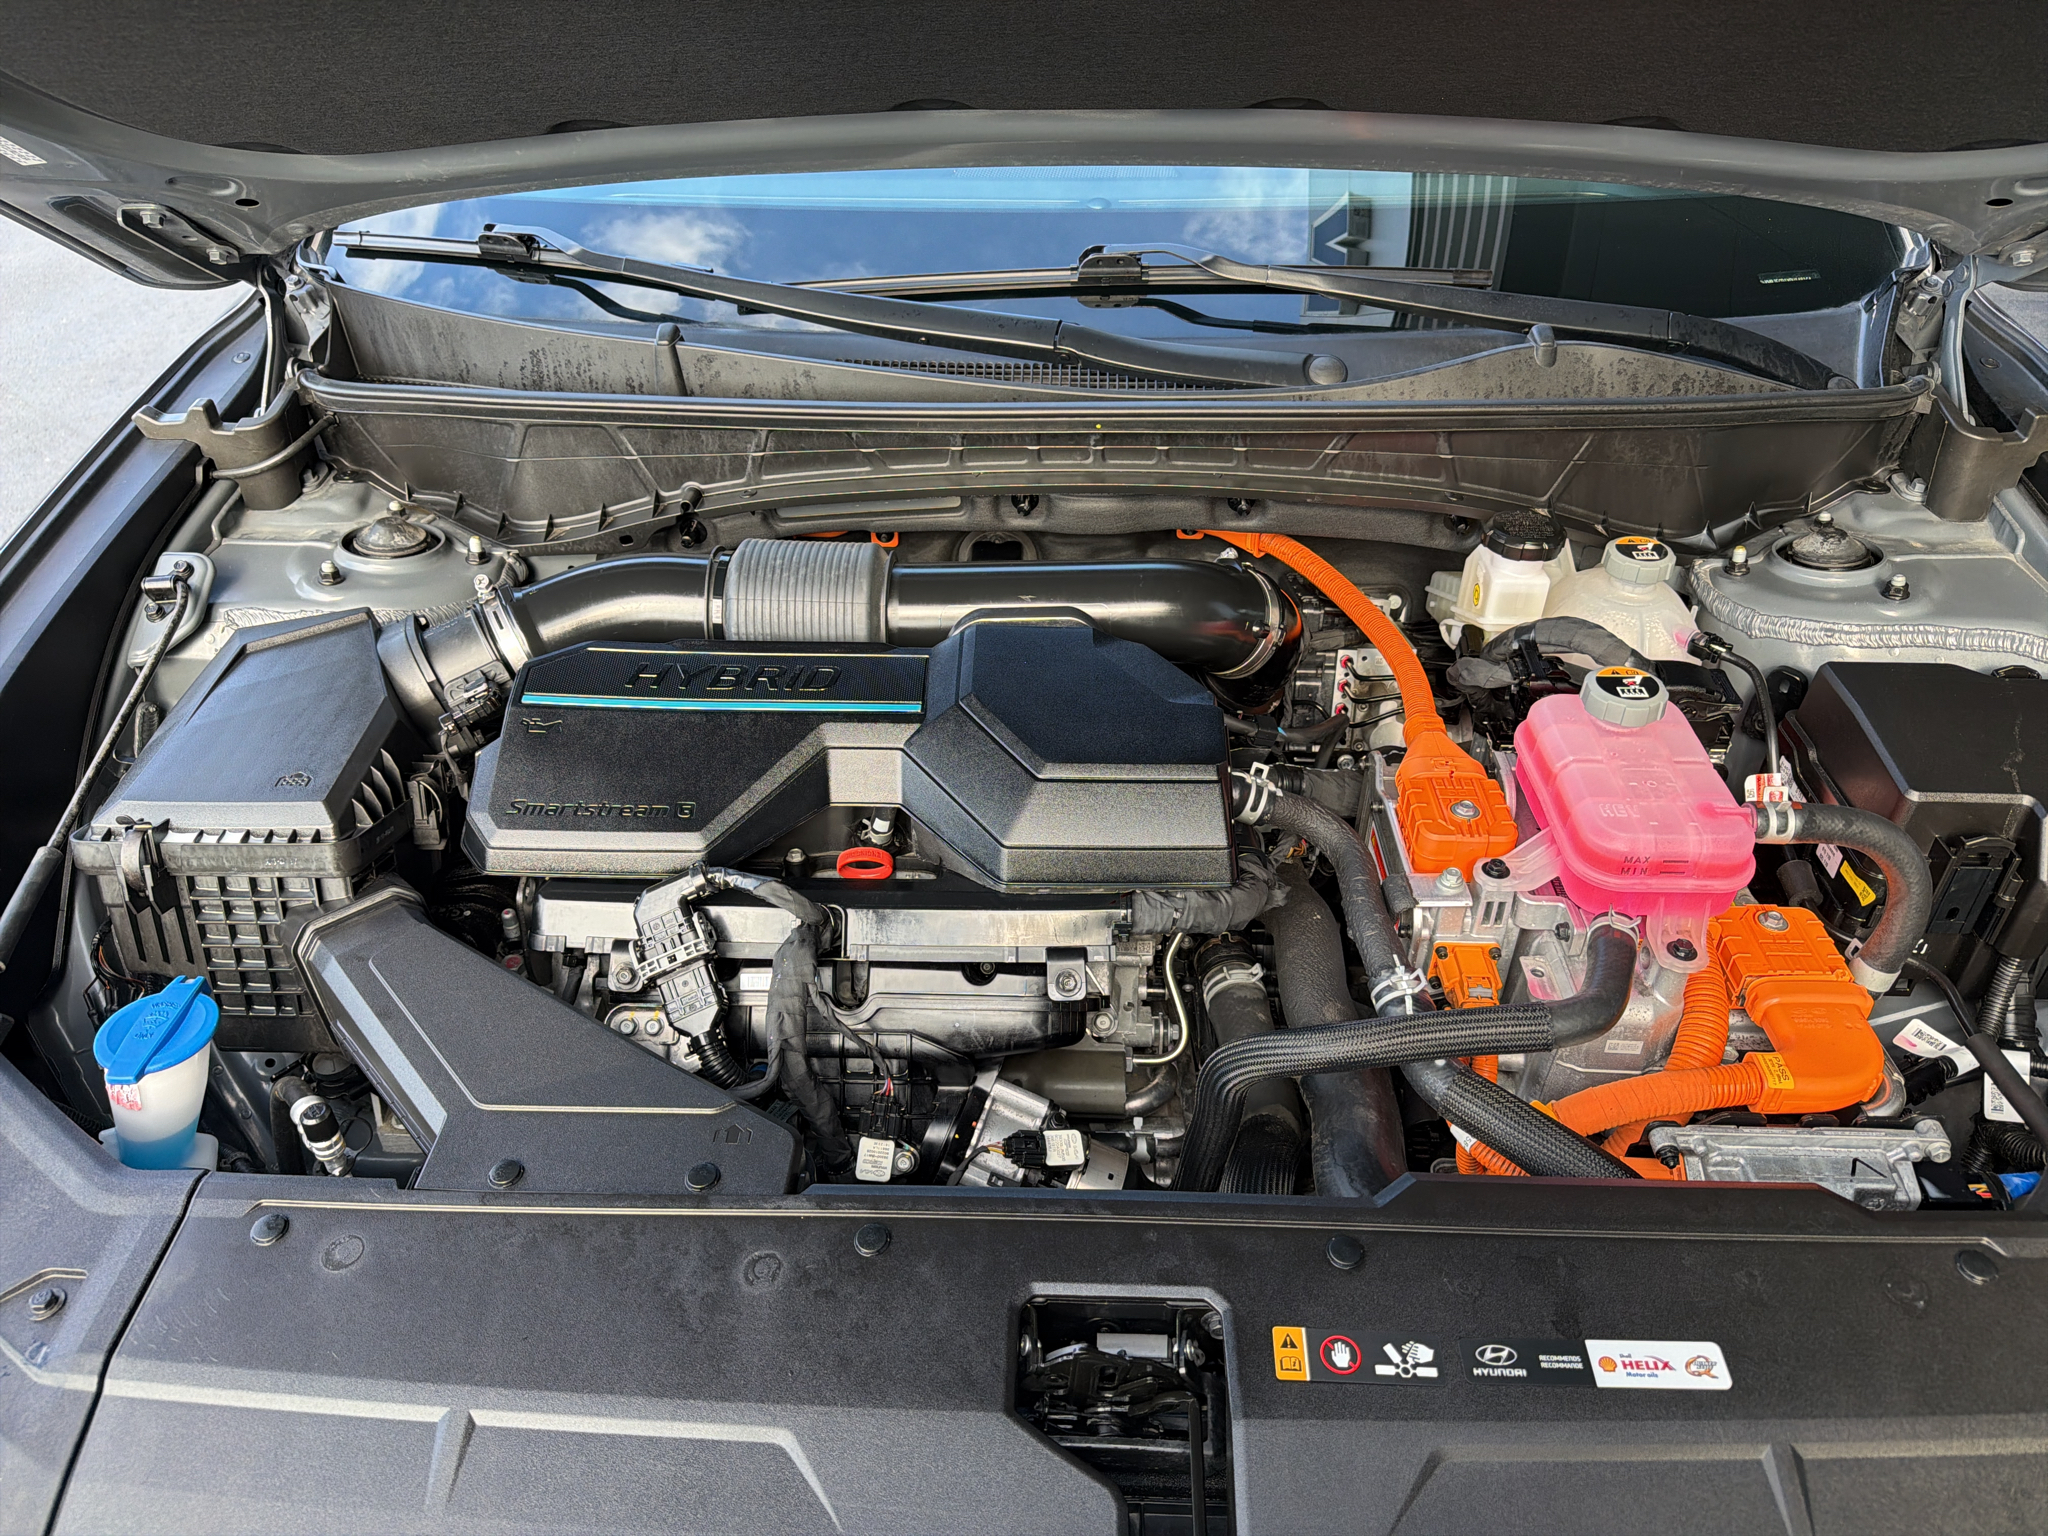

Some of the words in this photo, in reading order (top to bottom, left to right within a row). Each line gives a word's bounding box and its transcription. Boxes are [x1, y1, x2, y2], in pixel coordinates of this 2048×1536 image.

[624, 661, 842, 692] HYBRID
[505, 798, 671, 818] Smartstream
[1623, 856, 1651, 864] MAX
[1620, 867, 1649, 876] MIN
[1772, 1055, 1790, 1082] PASS
[1538, 1354, 1582, 1362] RECOMMENDS
[1620, 1359, 1674, 1371] HELIX
[1472, 1367, 1528, 1378] HYUNDAI
